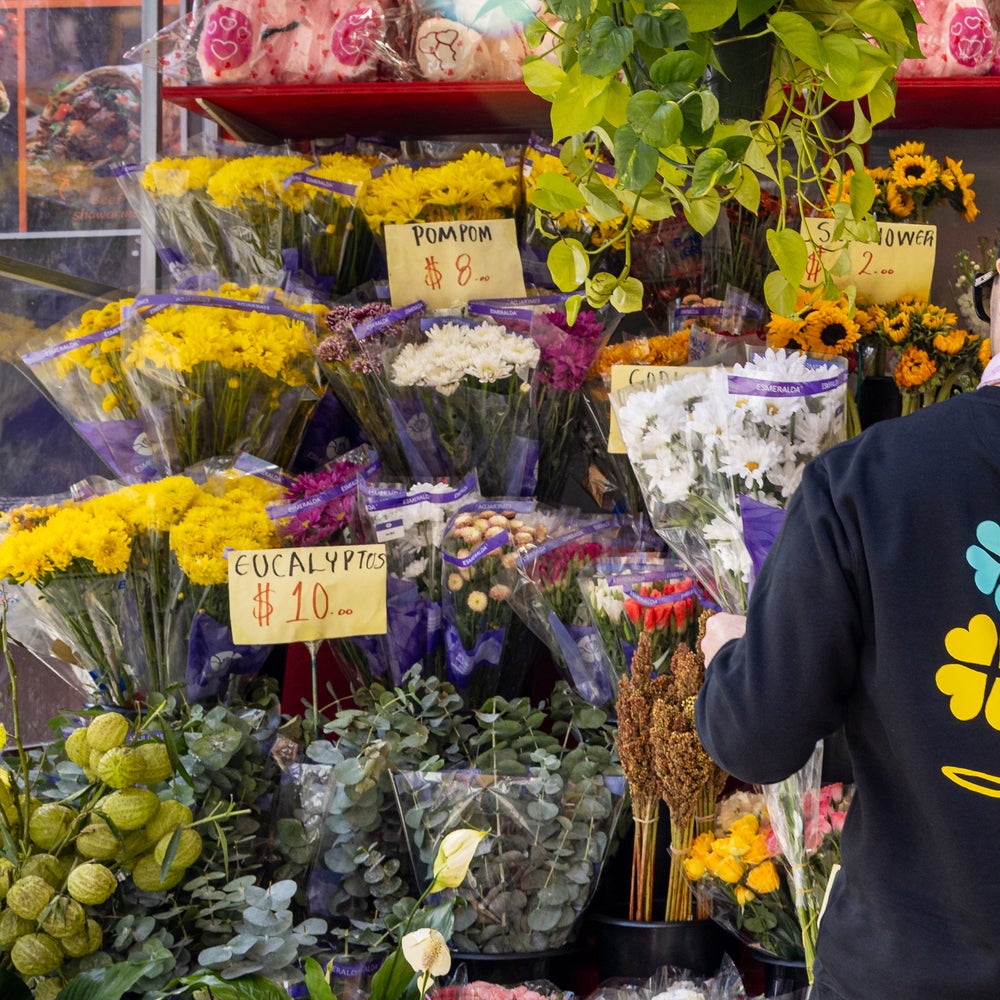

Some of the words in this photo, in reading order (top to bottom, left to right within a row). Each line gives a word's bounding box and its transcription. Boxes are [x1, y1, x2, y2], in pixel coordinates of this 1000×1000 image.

[412, 224, 493, 247] POMPOM
[489, 309, 519, 317] ESMERALDA
[756, 383, 802, 394] ESMERALDA
[288, 496, 322, 513] ESMERALDA
[235, 550, 387, 578] EUCALYPTOS
[462, 544, 489, 567] ESMERALDA
